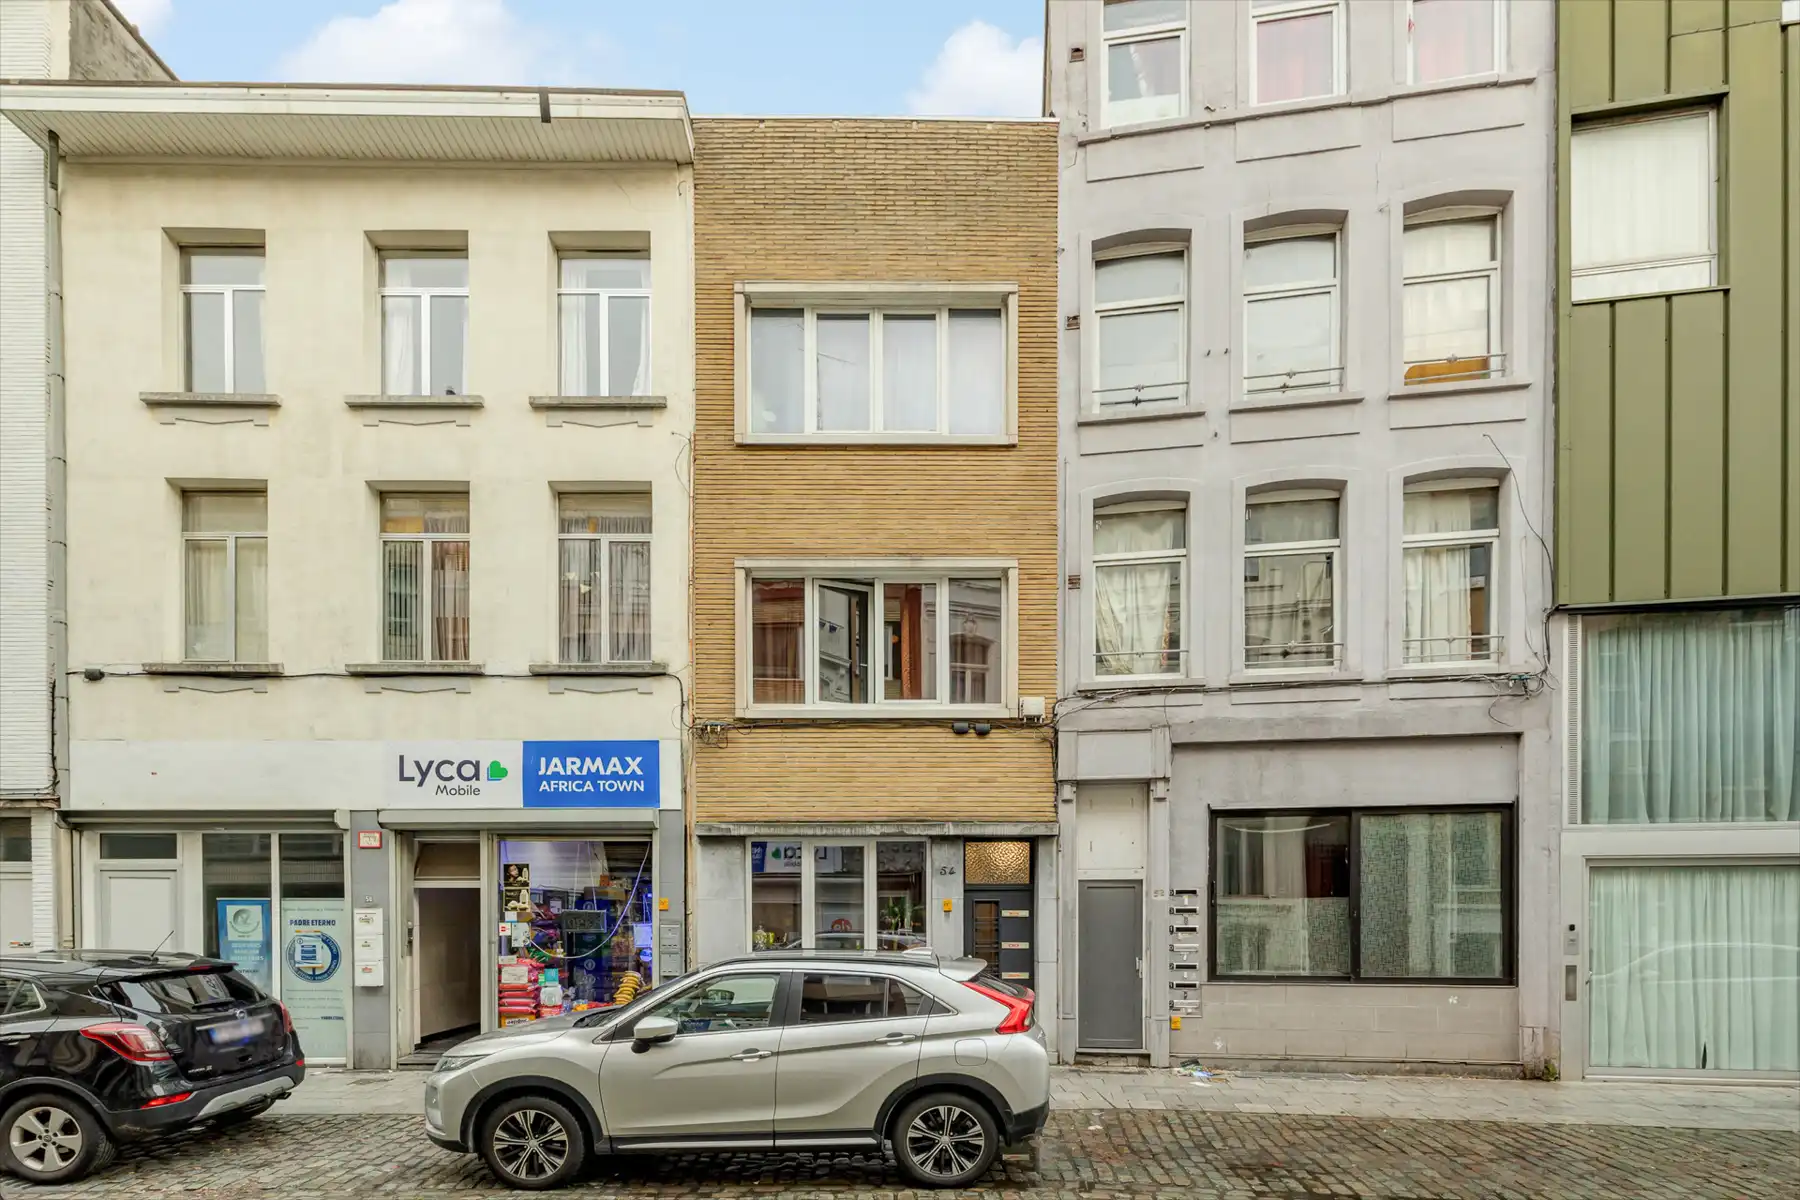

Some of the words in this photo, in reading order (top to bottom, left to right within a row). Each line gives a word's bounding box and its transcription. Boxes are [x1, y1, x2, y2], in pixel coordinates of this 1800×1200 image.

[399, 754, 481, 788] Lyca
[538, 756, 644, 776] JARMAX
[435, 784, 481, 796] Mobile
[538, 780, 595, 792] AFRICA
[597, 780, 645, 792] TOWN
